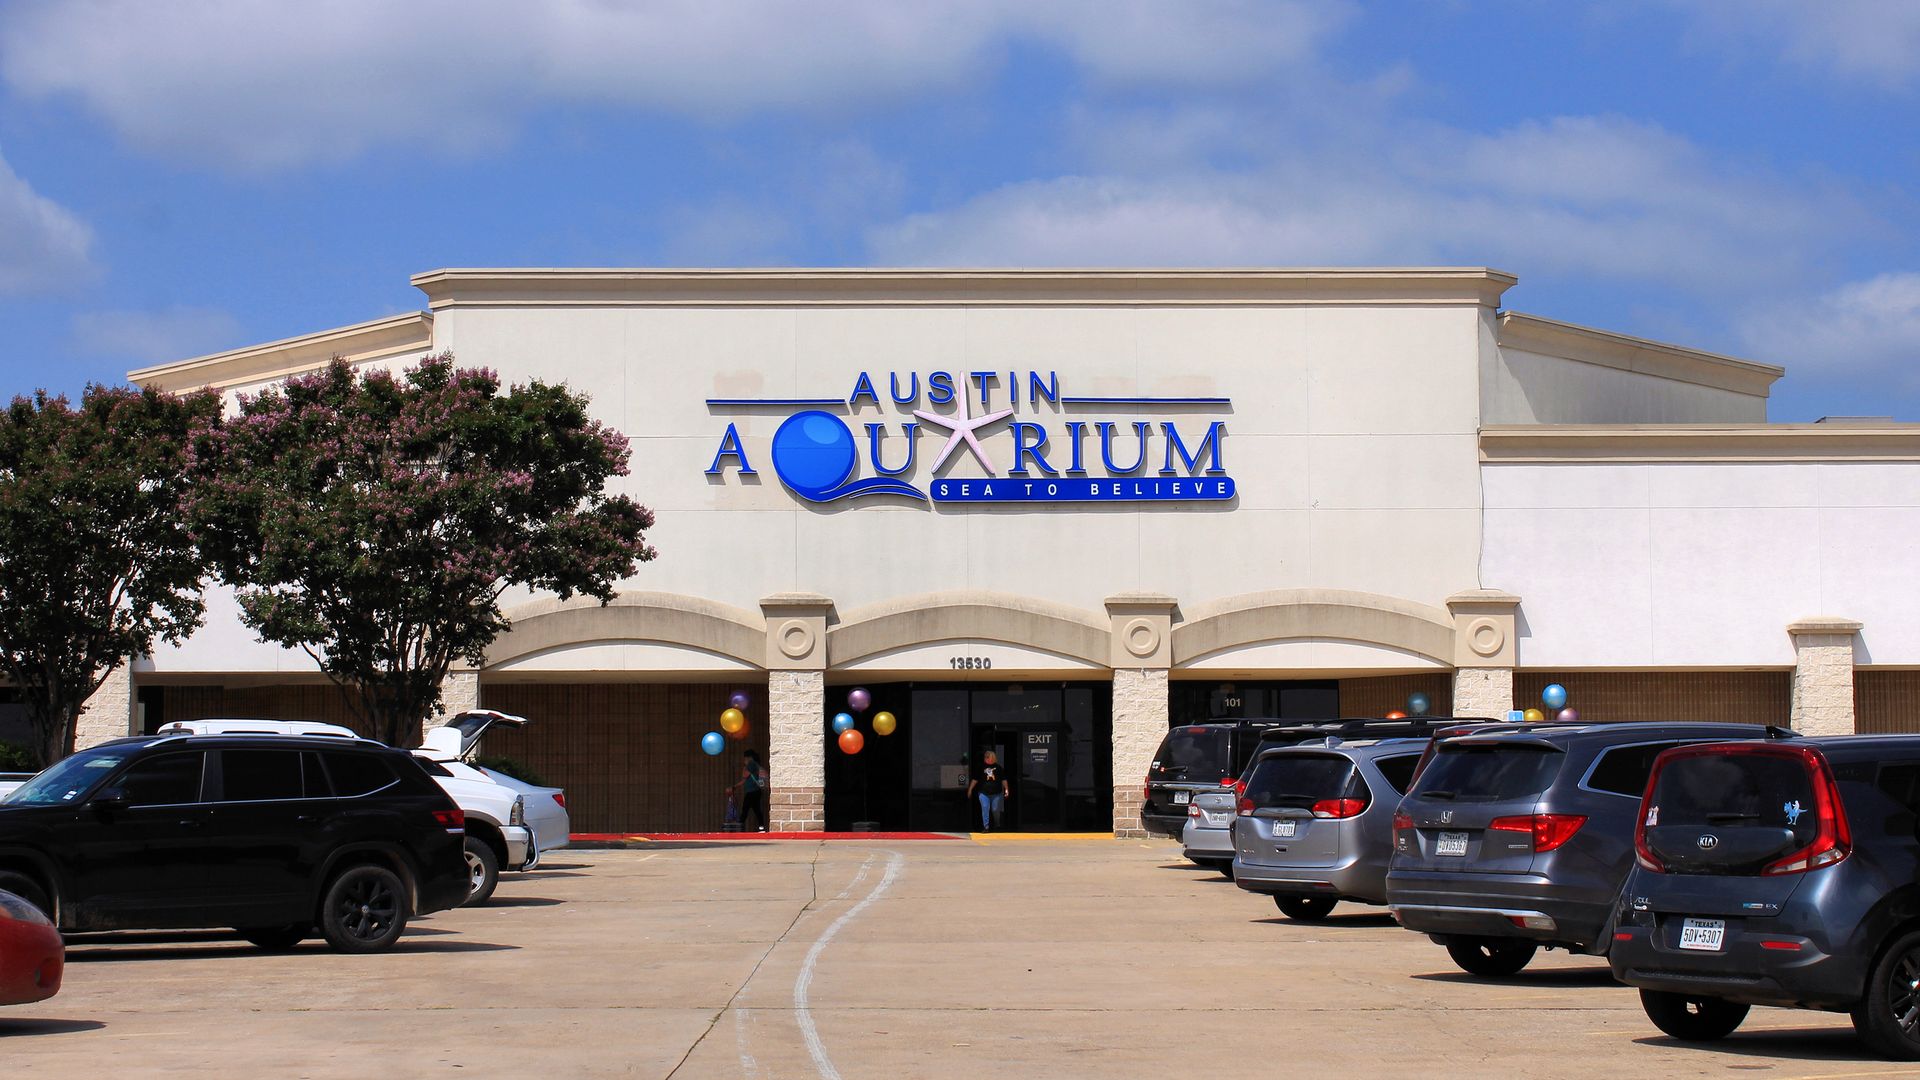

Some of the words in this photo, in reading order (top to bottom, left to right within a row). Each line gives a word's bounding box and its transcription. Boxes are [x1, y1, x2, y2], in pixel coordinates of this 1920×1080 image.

[849, 370, 1057, 404] AUSTIN
[940, 484, 993, 496] SEA
[1024, 484, 1057, 496] TO
[1090, 483, 1226, 496] BELIEVE
[949, 657, 992, 670] 13530
[1225, 698, 1241, 707] 101
[1028, 734, 1052, 744] EXIT
[1699, 836, 1715, 847] KIA
